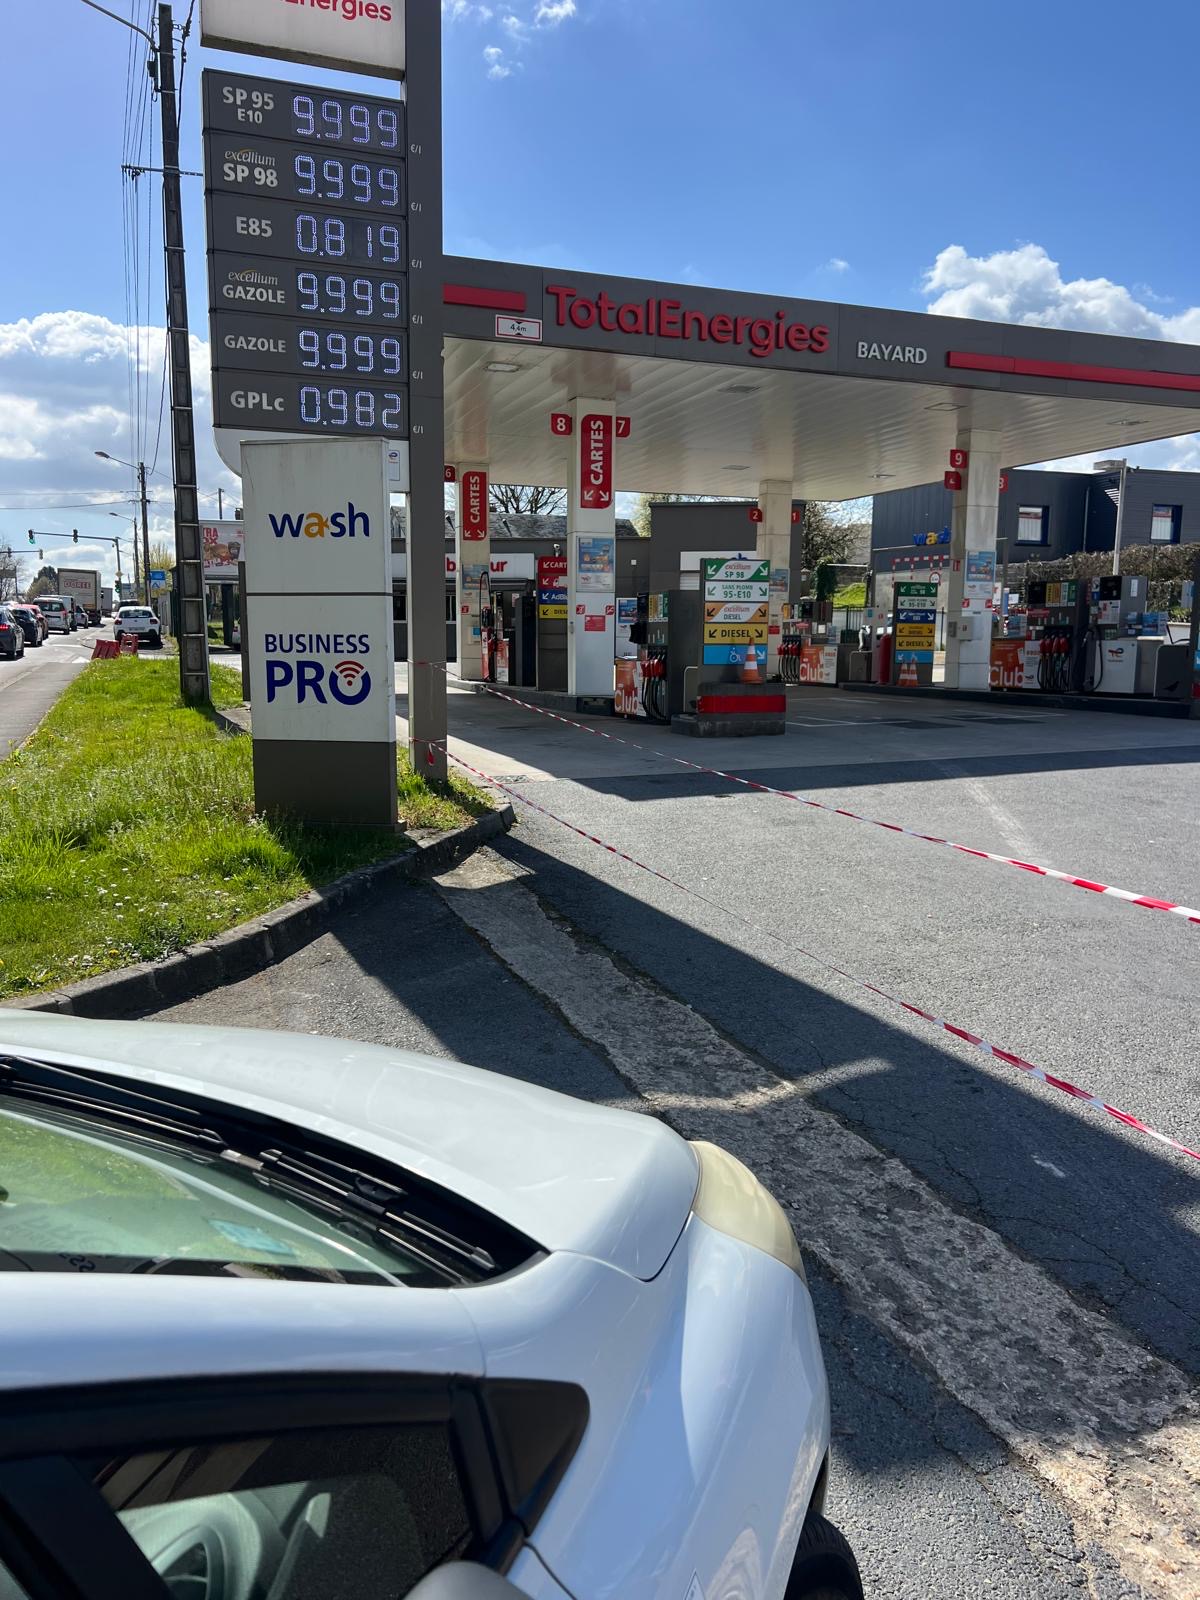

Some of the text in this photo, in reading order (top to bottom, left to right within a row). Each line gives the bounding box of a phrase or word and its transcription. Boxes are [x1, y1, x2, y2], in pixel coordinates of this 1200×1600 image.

[222, 86, 274, 110] SP 95
[237, 108, 263, 124] E10
[293, 95, 398, 148] 9.999
[224, 150, 276, 166] excellium
[223, 163, 278, 188] SP 98
[295, 155, 399, 206] 9.999
[236, 216, 273, 238] E85
[296, 214, 400, 262] 0.819
[228, 270, 278, 286] excellium
[222, 284, 286, 304] GAZOLE
[298, 272, 400, 318] 9.999
[546, 286, 829, 358] TotalEnergies
[224, 335, 286, 353] GAZOLE
[300, 330, 400, 374] 9.999
[858, 341, 928, 364] BAYARD
[230, 390, 284, 411] GPLc
[300, 386, 400, 428] 0.982
[556, 418, 566, 432] 8
[618, 420, 626, 434] 7
[590, 420, 604, 485] CARTES
[955, 452, 962, 464] 9
[445, 468, 452, 478] 6
[470, 476, 480, 523] CARTES
[268, 502, 370, 538] wash
[752, 510, 758, 520] 2
[792, 512, 796, 520] 1
[723, 590, 752, 598] 95-E10
[264, 634, 370, 654] BUSINESS
[721, 630, 752, 638] DIESEL
[800, 662, 824, 681] Club
[990, 666, 1024, 687] Club
[266, 660, 372, 706] PRO
[614, 690, 638, 714] Club
